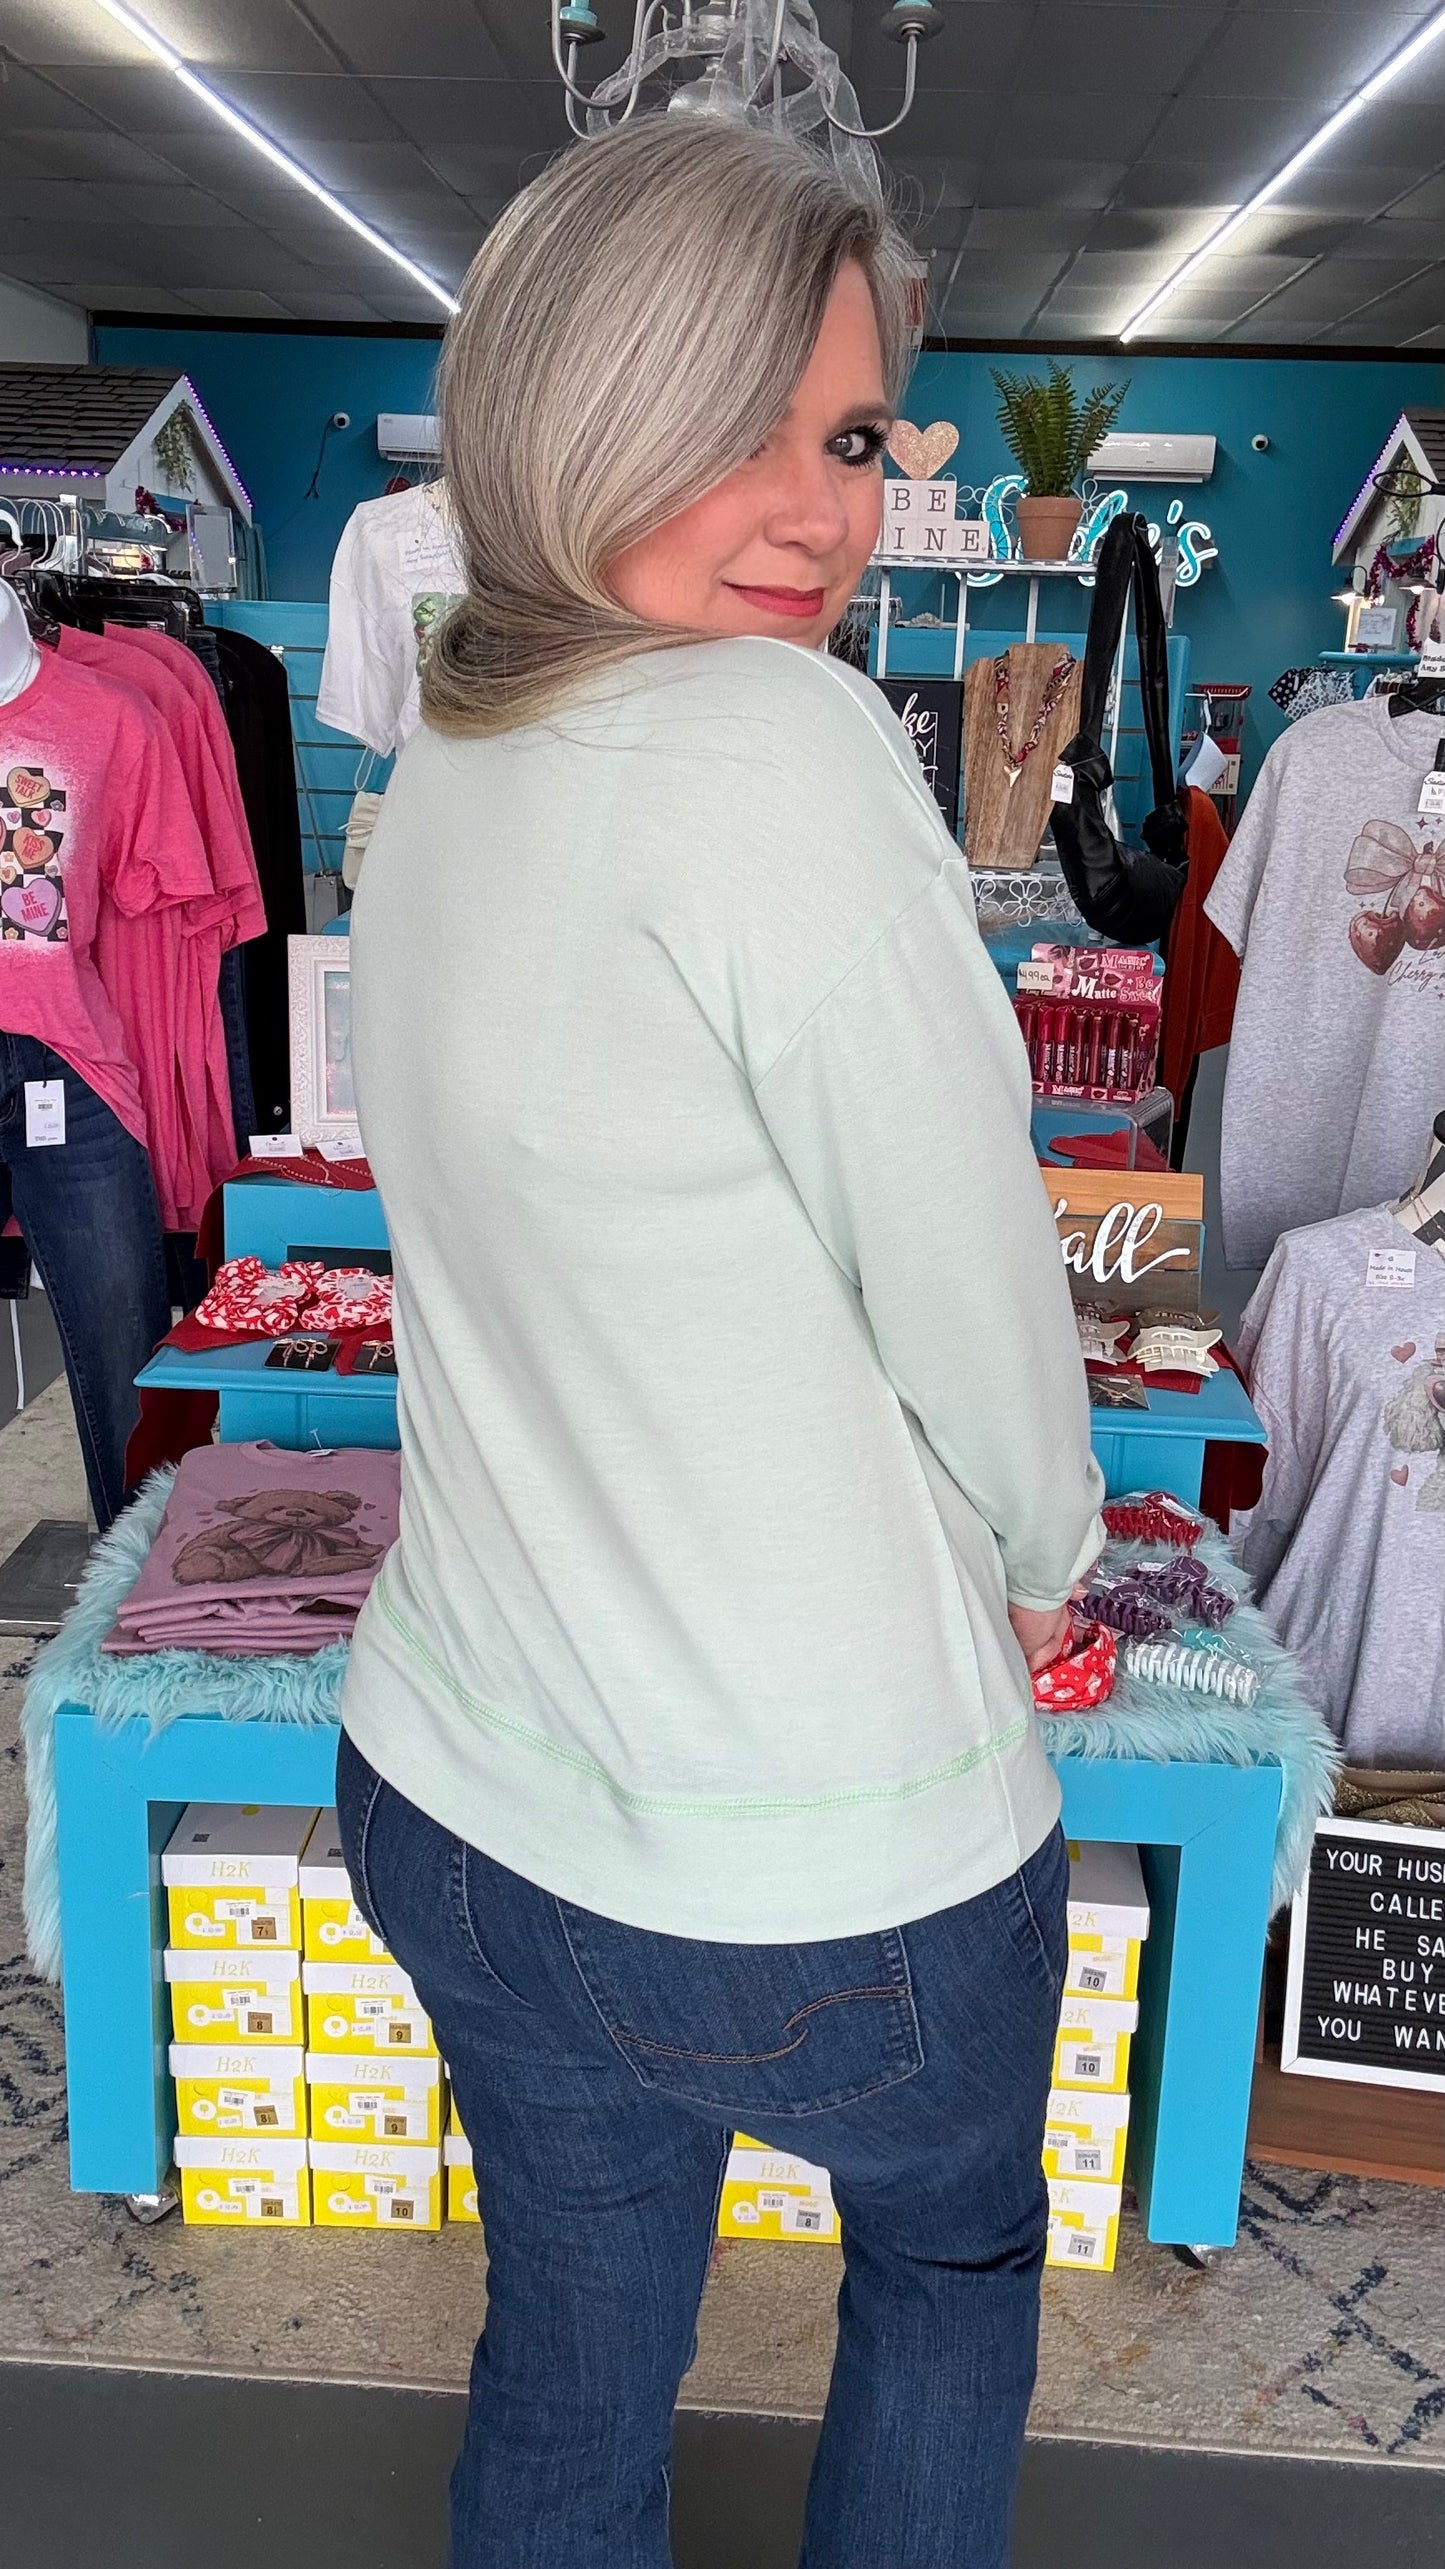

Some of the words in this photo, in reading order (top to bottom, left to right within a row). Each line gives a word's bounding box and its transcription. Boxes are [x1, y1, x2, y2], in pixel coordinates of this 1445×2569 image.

[891, 488, 946, 512] BE
[893, 526, 980, 552] INE
[902, 692, 935, 737] ke
[15, 774, 43, 793] SWEET
[15, 784, 35, 799] TALK
[23, 833, 45, 852] KISS
[22, 846, 36, 860] ME
[22, 891, 38, 907] BE
[21, 902, 49, 922] MINE
[1135, 975, 1154, 990] Be
[1388, 960, 1438, 992] Cherry
[1072, 974, 1117, 999] Matte
[1054, 1198, 1191, 1284] 'all
[211, 1861, 252, 1878] H2K
[1326, 1848, 1383, 1877] YOUR
[1397, 1857, 1445, 1884] HUS
[1370, 1891, 1444, 1920] CALLE
[1069, 1910, 1097, 1927] 2K
[1355, 1926, 1386, 1951] HE
[212, 1960, 254, 1976] H2K
[1383, 1958, 1434, 1985] BUY
[351, 1973, 392, 1990] H2K
[1086, 1976, 1100, 1988] 10
[1064, 2007, 1090, 2024] 2K
[256, 2020, 264, 2031] 8
[1318, 2015, 1361, 2042] YOU
[396, 2030, 403, 2041] 9
[216, 2056, 257, 2073] H2K
[354, 2064, 395, 2080] H2K
[1081, 2062, 1096, 2073] 10
[391, 2123, 398, 2134] 9
[221, 2147, 262, 2164] H2K
[354, 2149, 395, 2167] H2K
[1082, 2159, 1095, 2168] 11
[761, 2162, 801, 2180] H2K
[395, 2207, 408, 2217] 10
[805, 2217, 812, 2228] 8
[1077, 2244, 1088, 2255] 11
